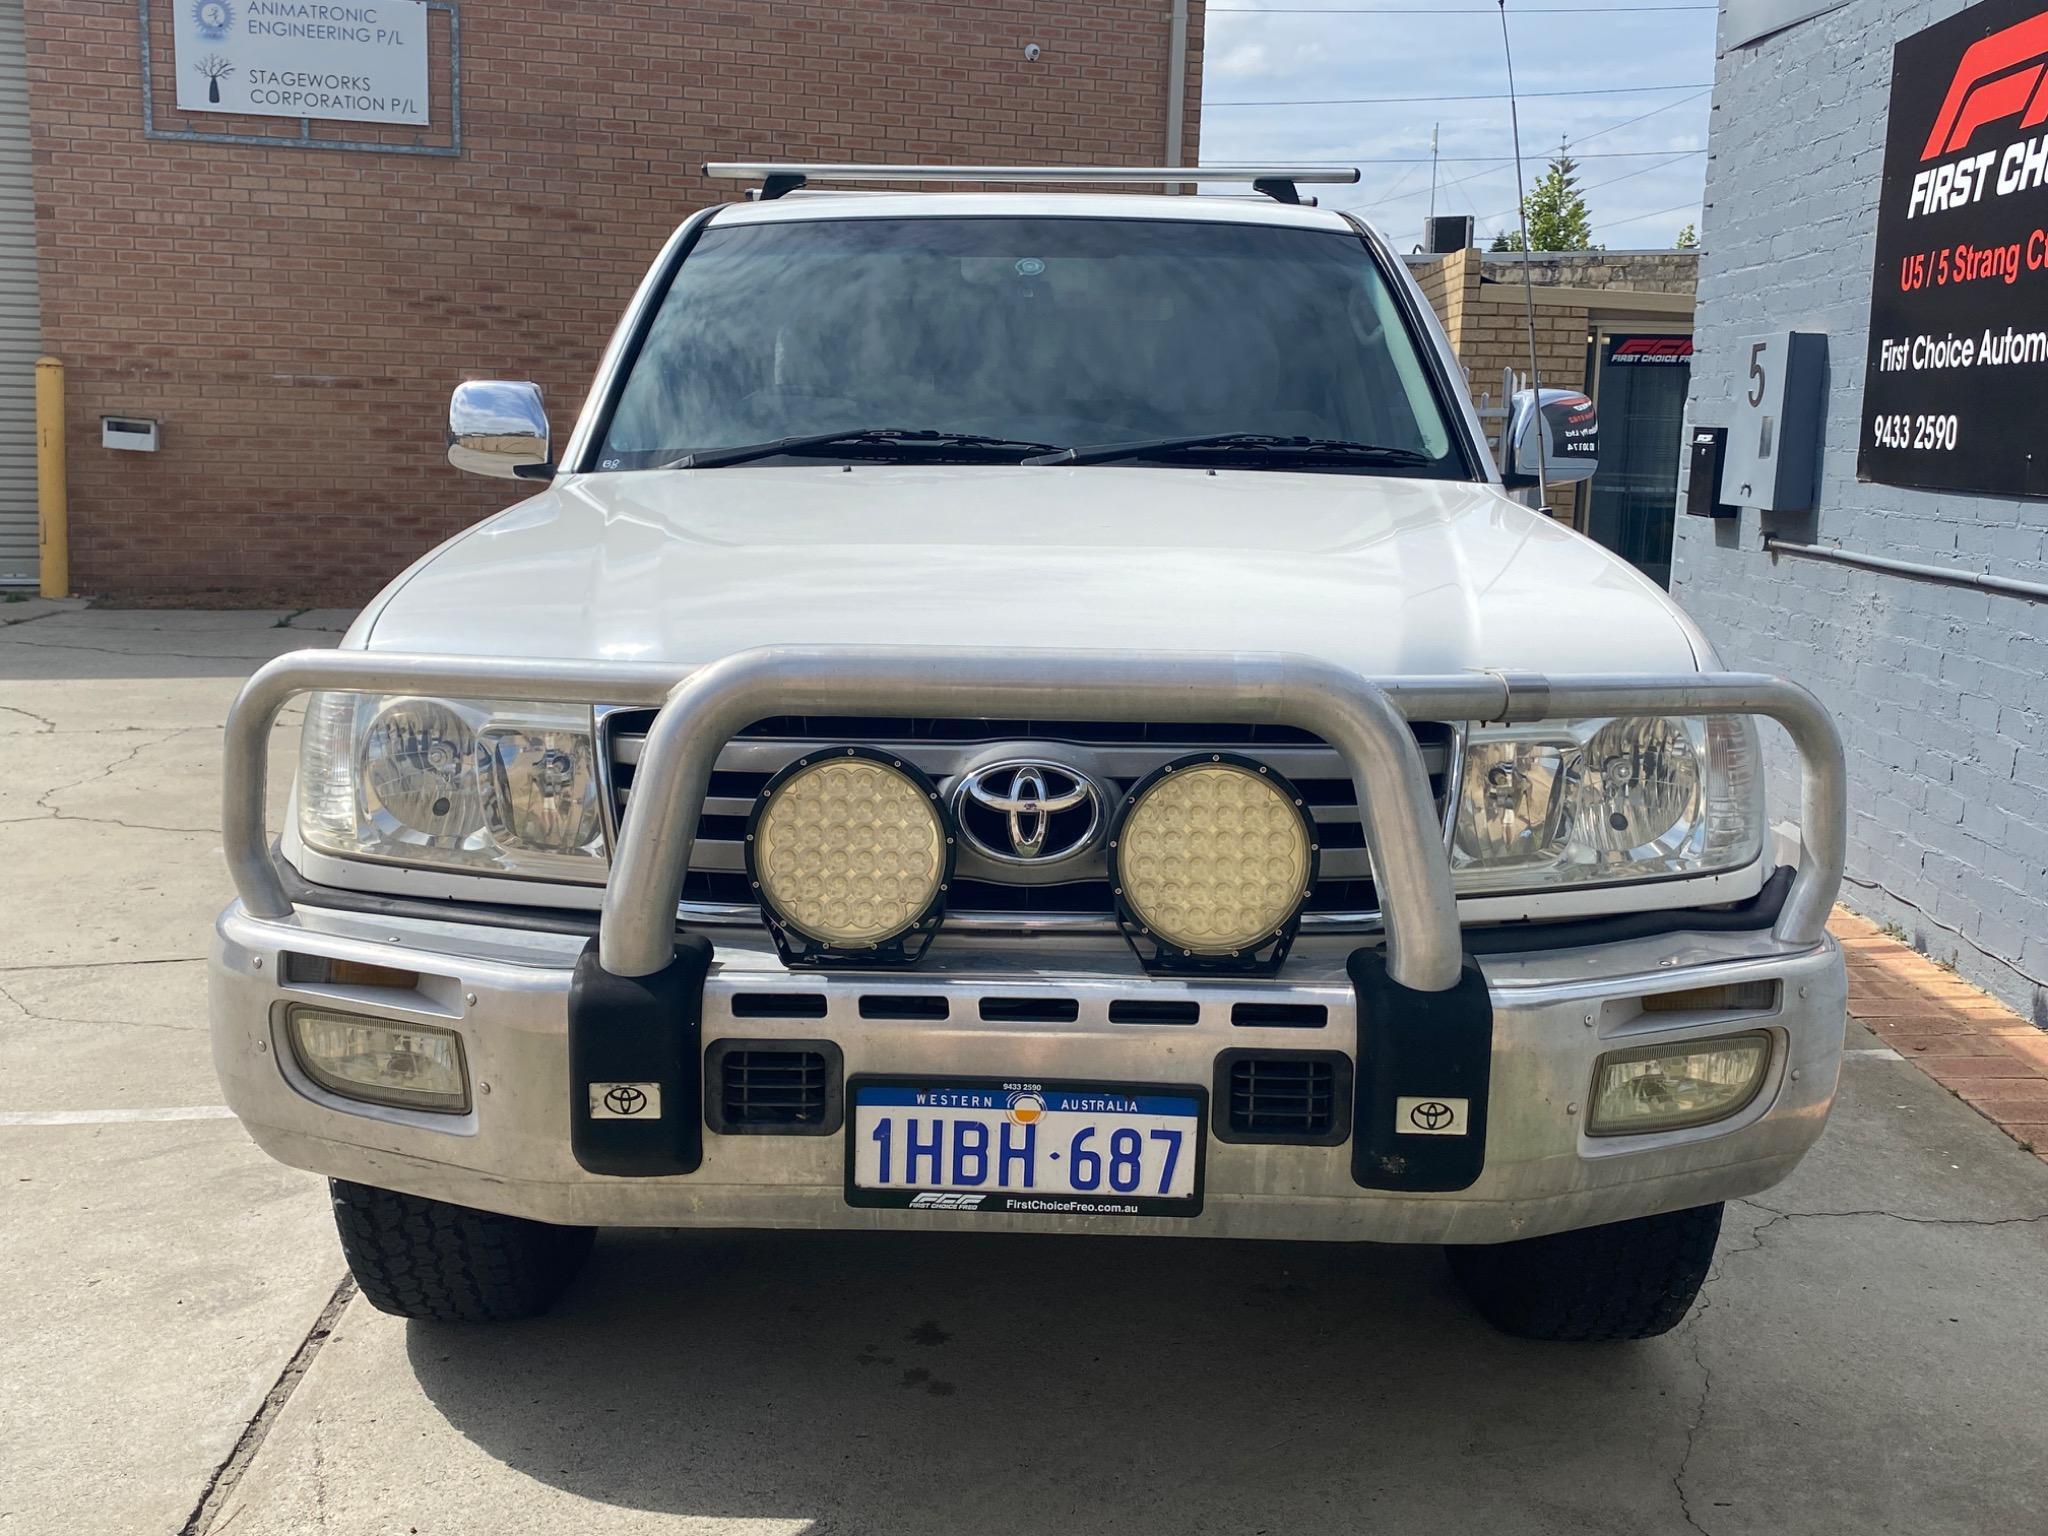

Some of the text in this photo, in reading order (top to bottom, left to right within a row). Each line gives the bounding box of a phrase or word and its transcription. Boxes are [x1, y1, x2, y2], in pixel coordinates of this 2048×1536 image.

[247, 0, 377, 24] ANIMATRONIC
[248, 19, 404, 45] ENGINEERING P/L
[249, 69, 371, 92] STAGEWORKS
[250, 89, 418, 114] CORPORATION P/L
[1907, 133, 2048, 219] FIRST CH
[1900, 254, 1925, 292] U5
[1937, 248, 1950, 286] 5
[1952, 243, 2020, 285] Strang
[1611, 354, 1641, 363] FIRST
[1641, 354, 1678, 363] CHOICE
[1879, 326, 2048, 373] First Choice Autom
[1747, 342, 1767, 408] 5
[1874, 414, 1958, 451] 9433 2590
[916, 1094, 1138, 1113] WESTERN AUSTRALIA
[1006, 1199, 1138, 1214] FirstChoiceFreo.com.au
